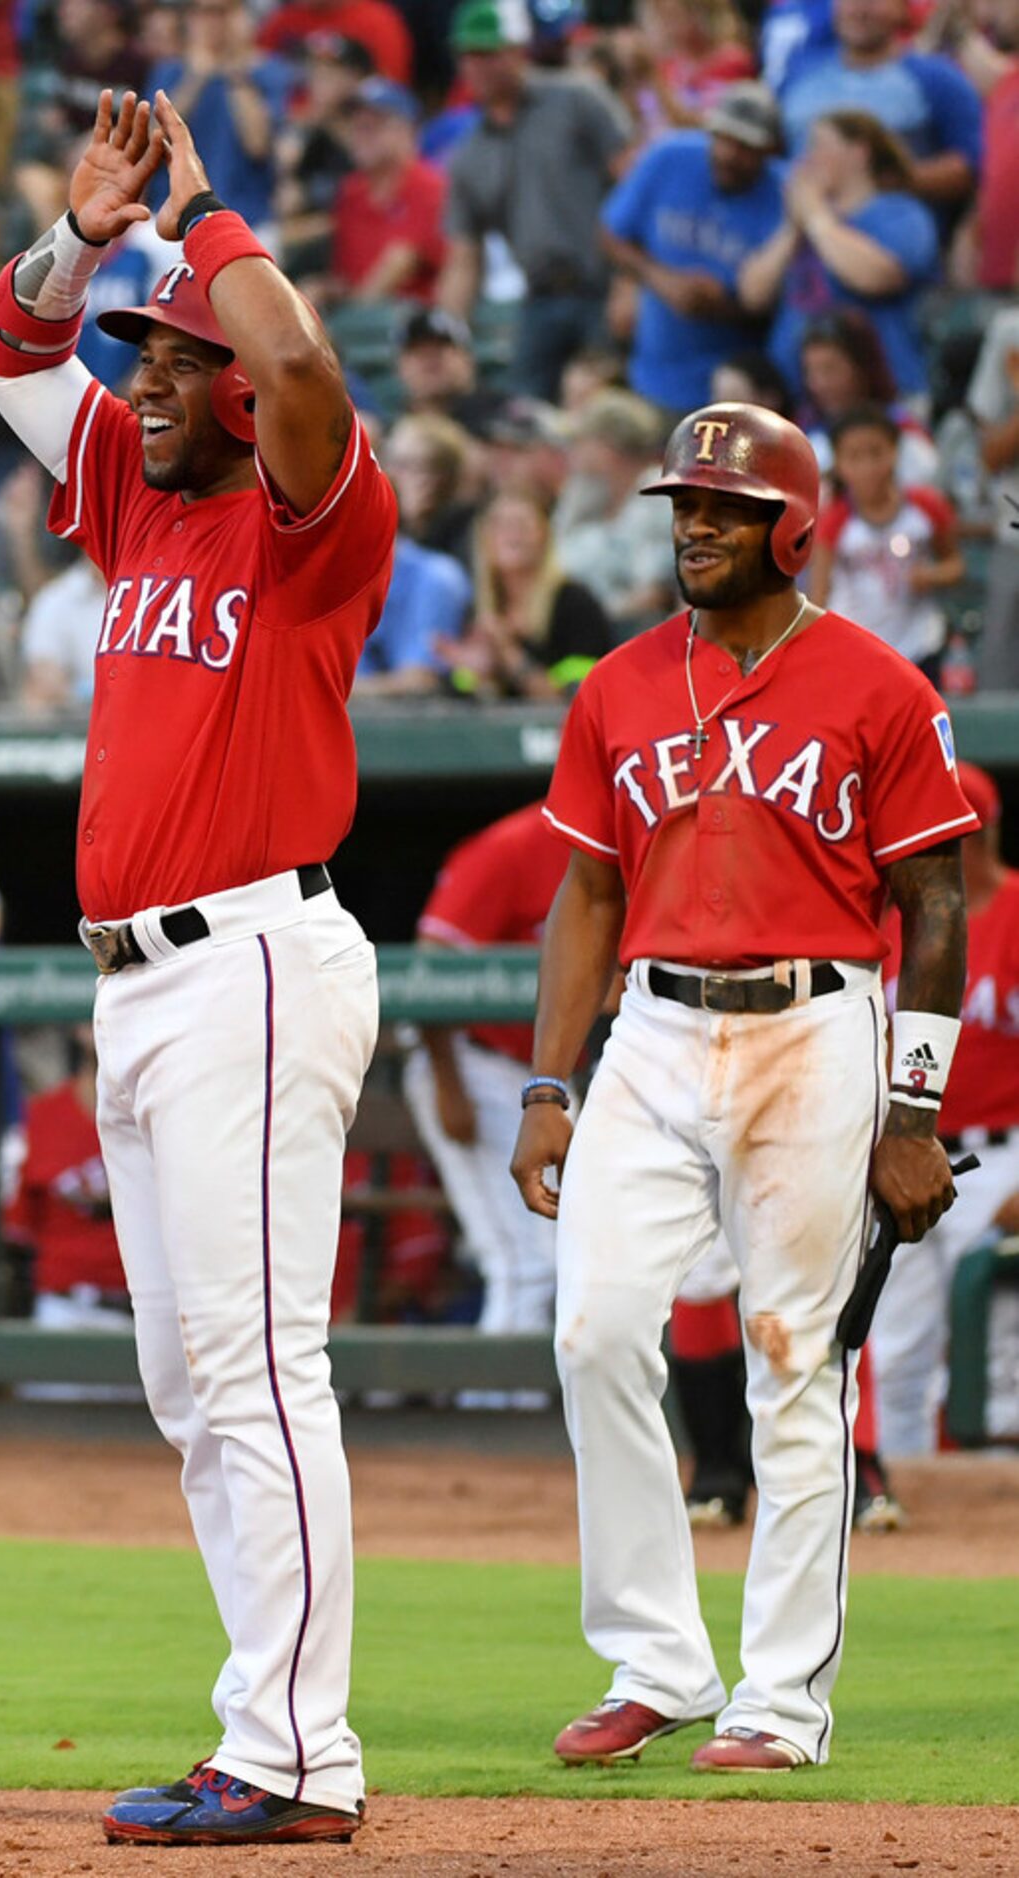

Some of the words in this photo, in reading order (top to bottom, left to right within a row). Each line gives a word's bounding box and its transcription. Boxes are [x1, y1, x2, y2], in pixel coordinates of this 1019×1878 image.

[157, 261, 194, 303] T
[693, 420, 730, 464] T
[96, 573, 249, 673] EXAS
[612, 715, 863, 842] TEXAS
